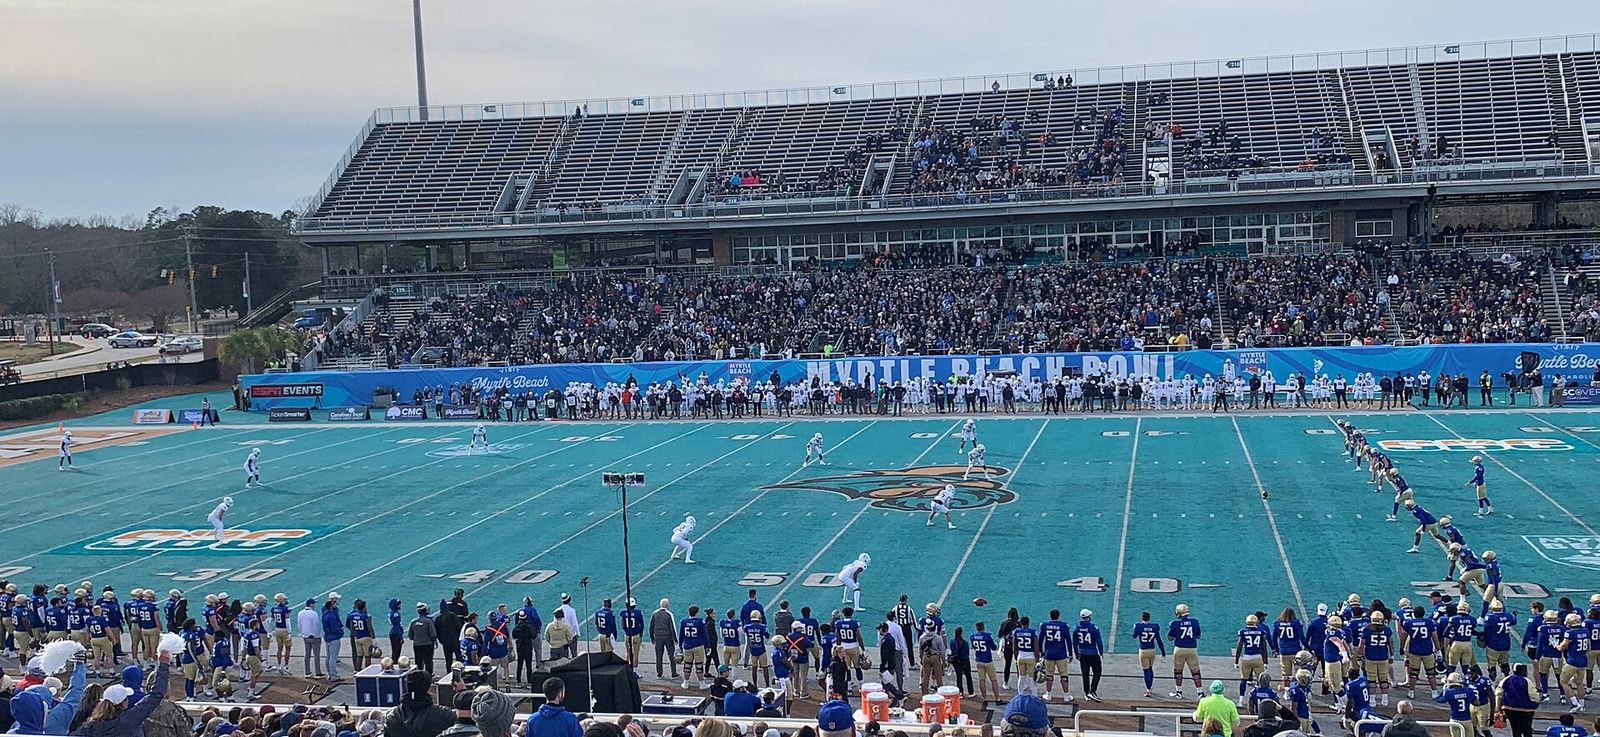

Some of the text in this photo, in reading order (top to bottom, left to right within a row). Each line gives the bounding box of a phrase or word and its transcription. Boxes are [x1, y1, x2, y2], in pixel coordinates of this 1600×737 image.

[807, 359, 935, 392] MYRTLE
[471, 375, 549, 392] Myrtle Beach
[283, 386, 322, 395] EVENTS
[401, 408, 422, 416] CMC
[171, 568, 286, 581] 30
[447, 569, 561, 584] 40
[737, 571, 842, 587] 50
[1056, 576, 1181, 593] 40
[140, 611, 151, 621] 98
[899, 608, 905, 618] S
[684, 627, 698, 638] 62
[722, 628, 736, 638] 90
[839, 629, 854, 640] 80
[1046, 630, 1062, 642] 54
[1140, 631, 1155, 643] 27
[1180, 626, 1193, 639] 74
[1278, 627, 1294, 639] 70
[1411, 626, 1428, 639] 79
[1457, 625, 1473, 637] 46
[1016, 637, 1032, 649] 22
[1077, 632, 1092, 644] 34
[1244, 636, 1261, 648] 34
[1370, 634, 1387, 646] 52
[972, 640, 987, 652] 95
[1577, 638, 1588, 651] 38
[1362, 687, 1369, 702] 8
[872, 705, 880, 713] G
[929, 707, 937, 715] G
[1457, 699, 1465, 712] 3
